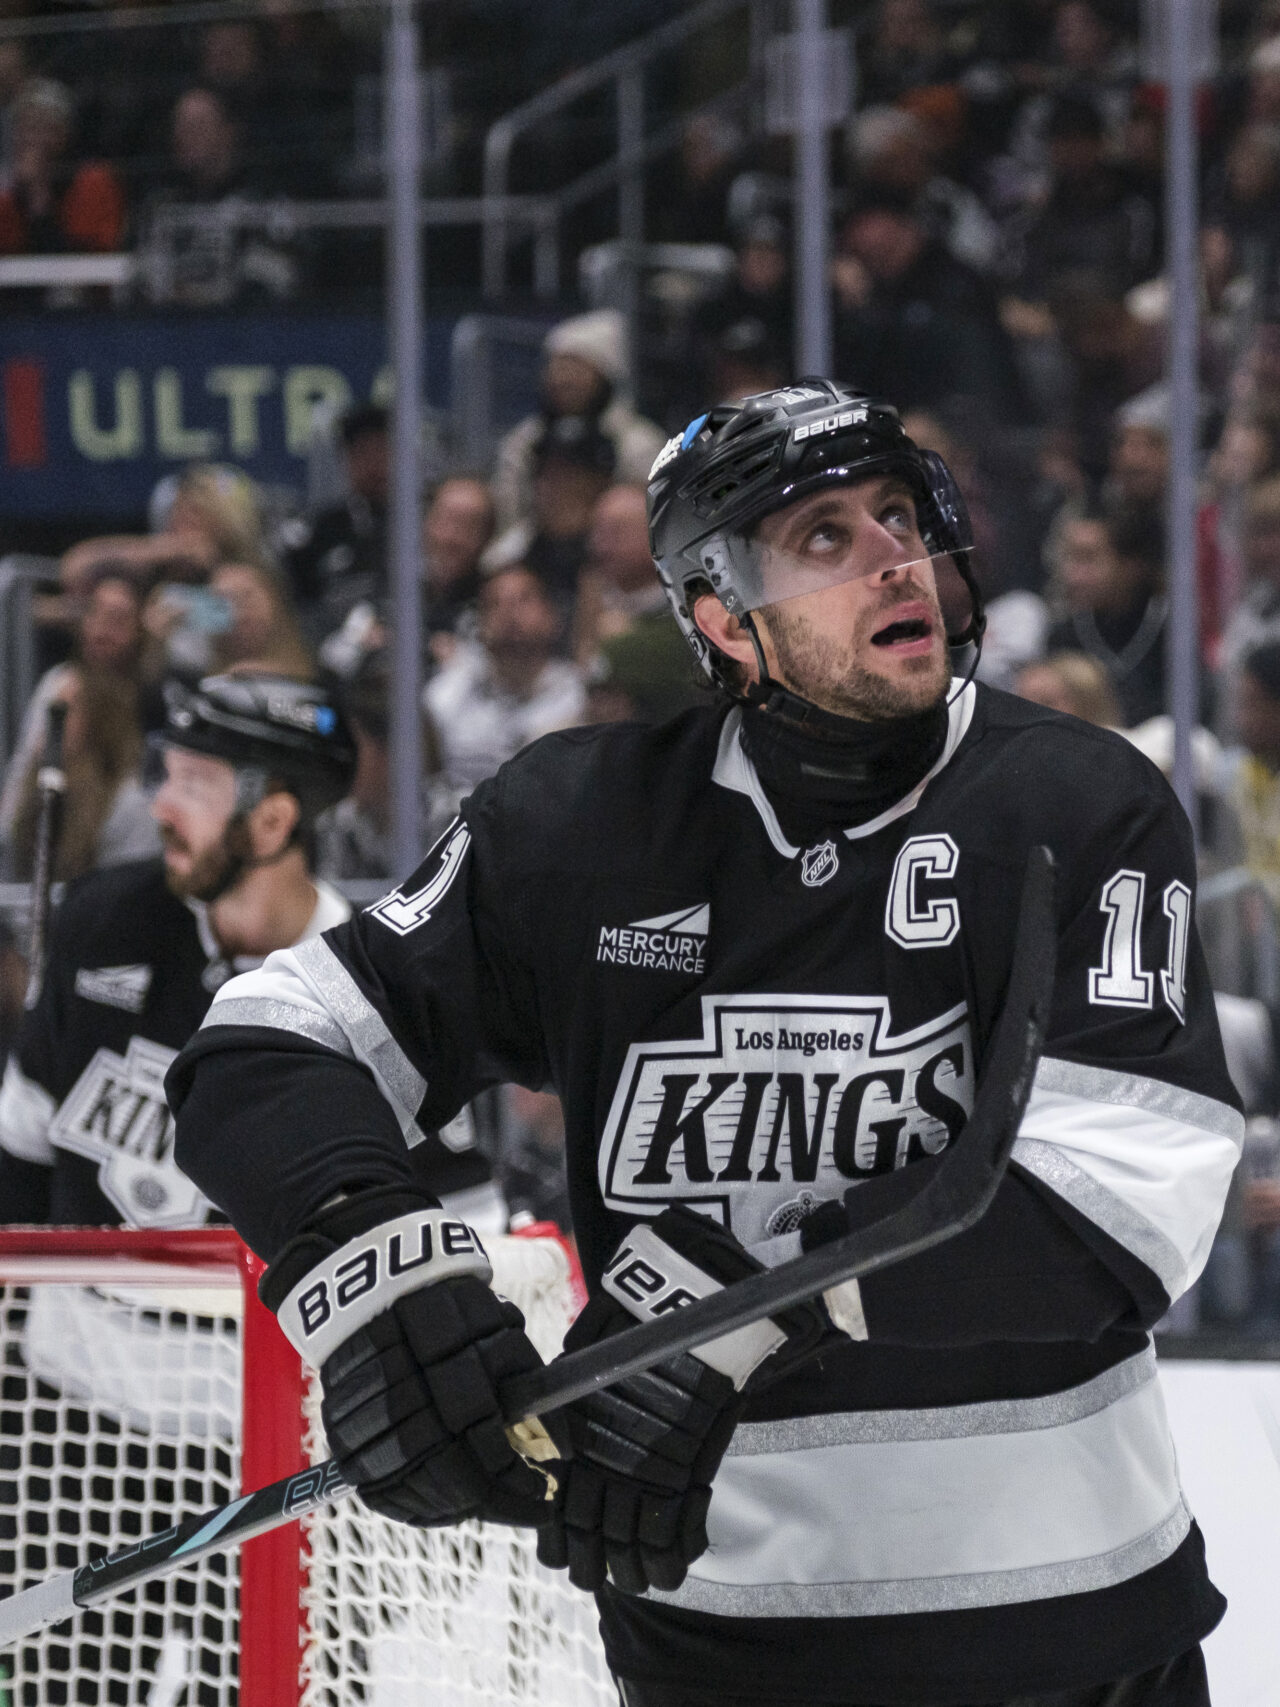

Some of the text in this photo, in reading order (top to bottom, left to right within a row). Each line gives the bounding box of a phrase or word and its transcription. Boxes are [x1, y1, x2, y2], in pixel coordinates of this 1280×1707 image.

[809, 851, 832, 881] NHL
[884, 833, 961, 950] C
[599, 925, 707, 957] MERCURY
[1088, 867, 1192, 1027] 11
[596, 945, 706, 974] INSURANCE
[735, 1028, 865, 1057] Los Angeles
[632, 1041, 972, 1186] KINGS
